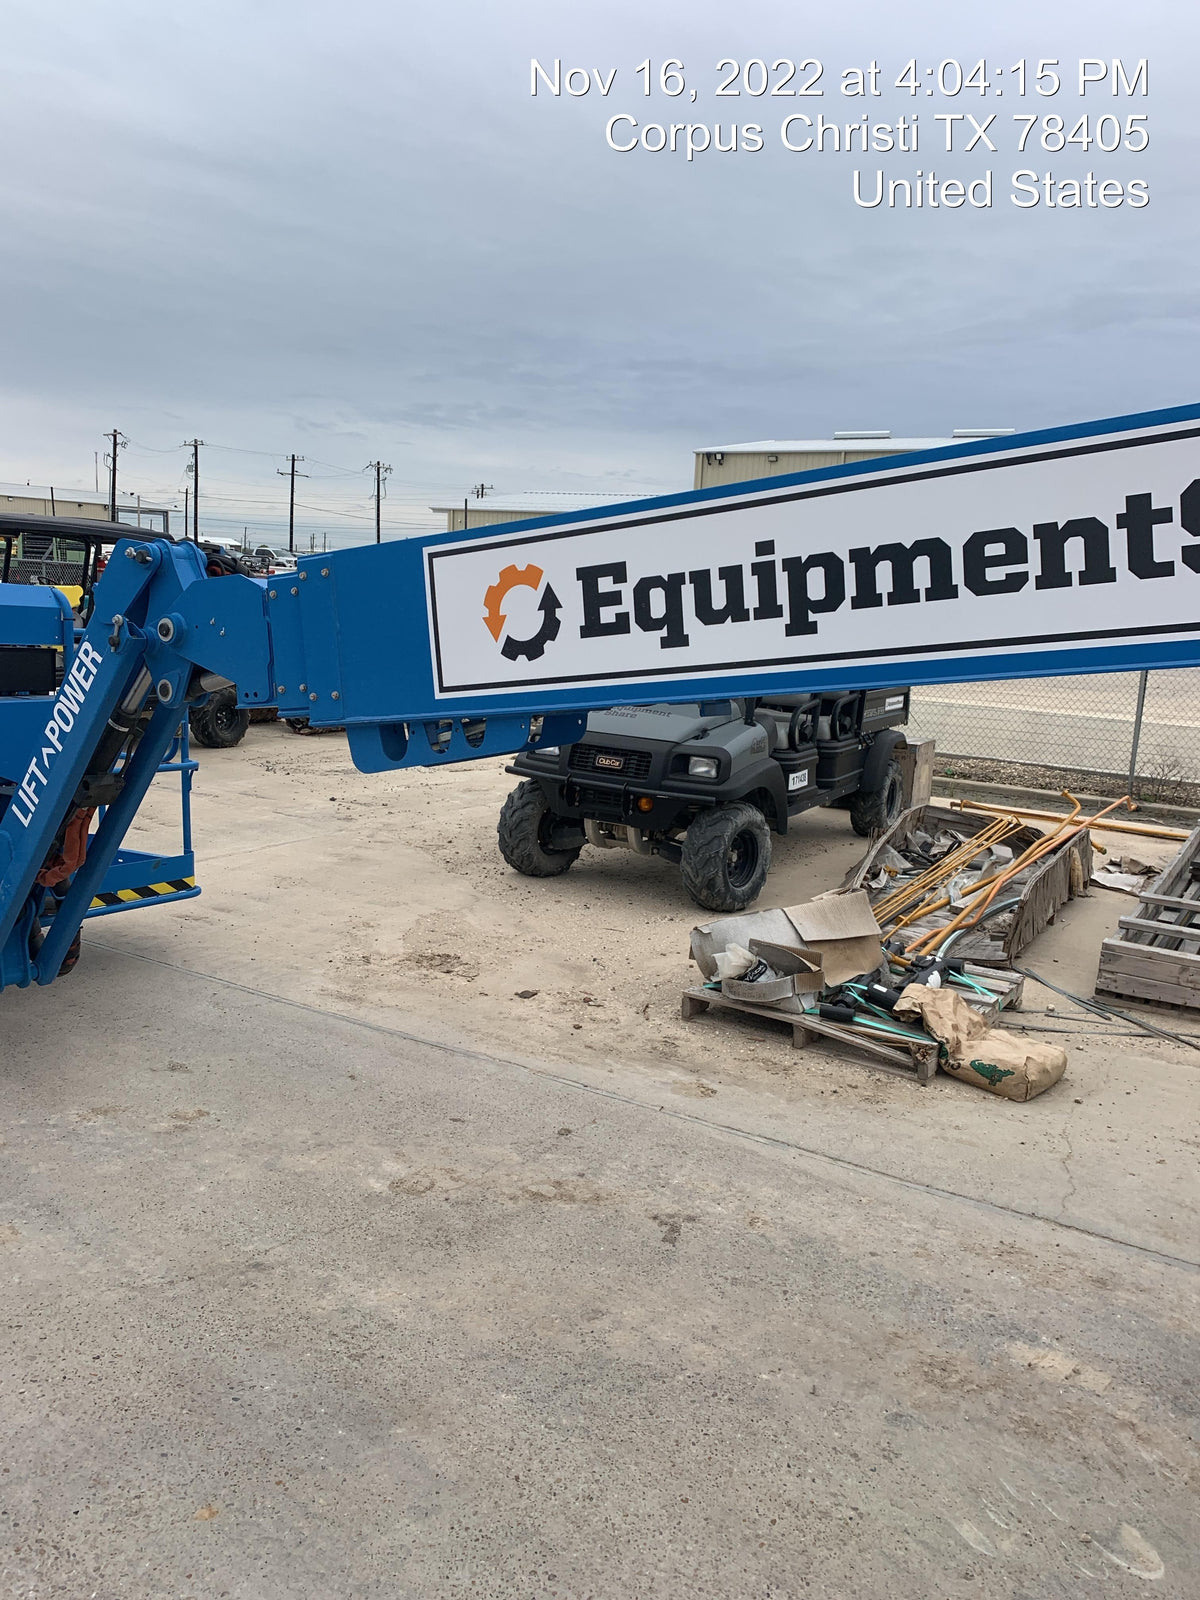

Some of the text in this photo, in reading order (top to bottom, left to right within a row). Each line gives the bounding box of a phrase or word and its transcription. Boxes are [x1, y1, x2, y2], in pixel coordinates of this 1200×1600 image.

[576, 478, 1200, 649] Equipment
[12, 641, 103, 828] LIFT POWER
[604, 710, 637, 718] Share
